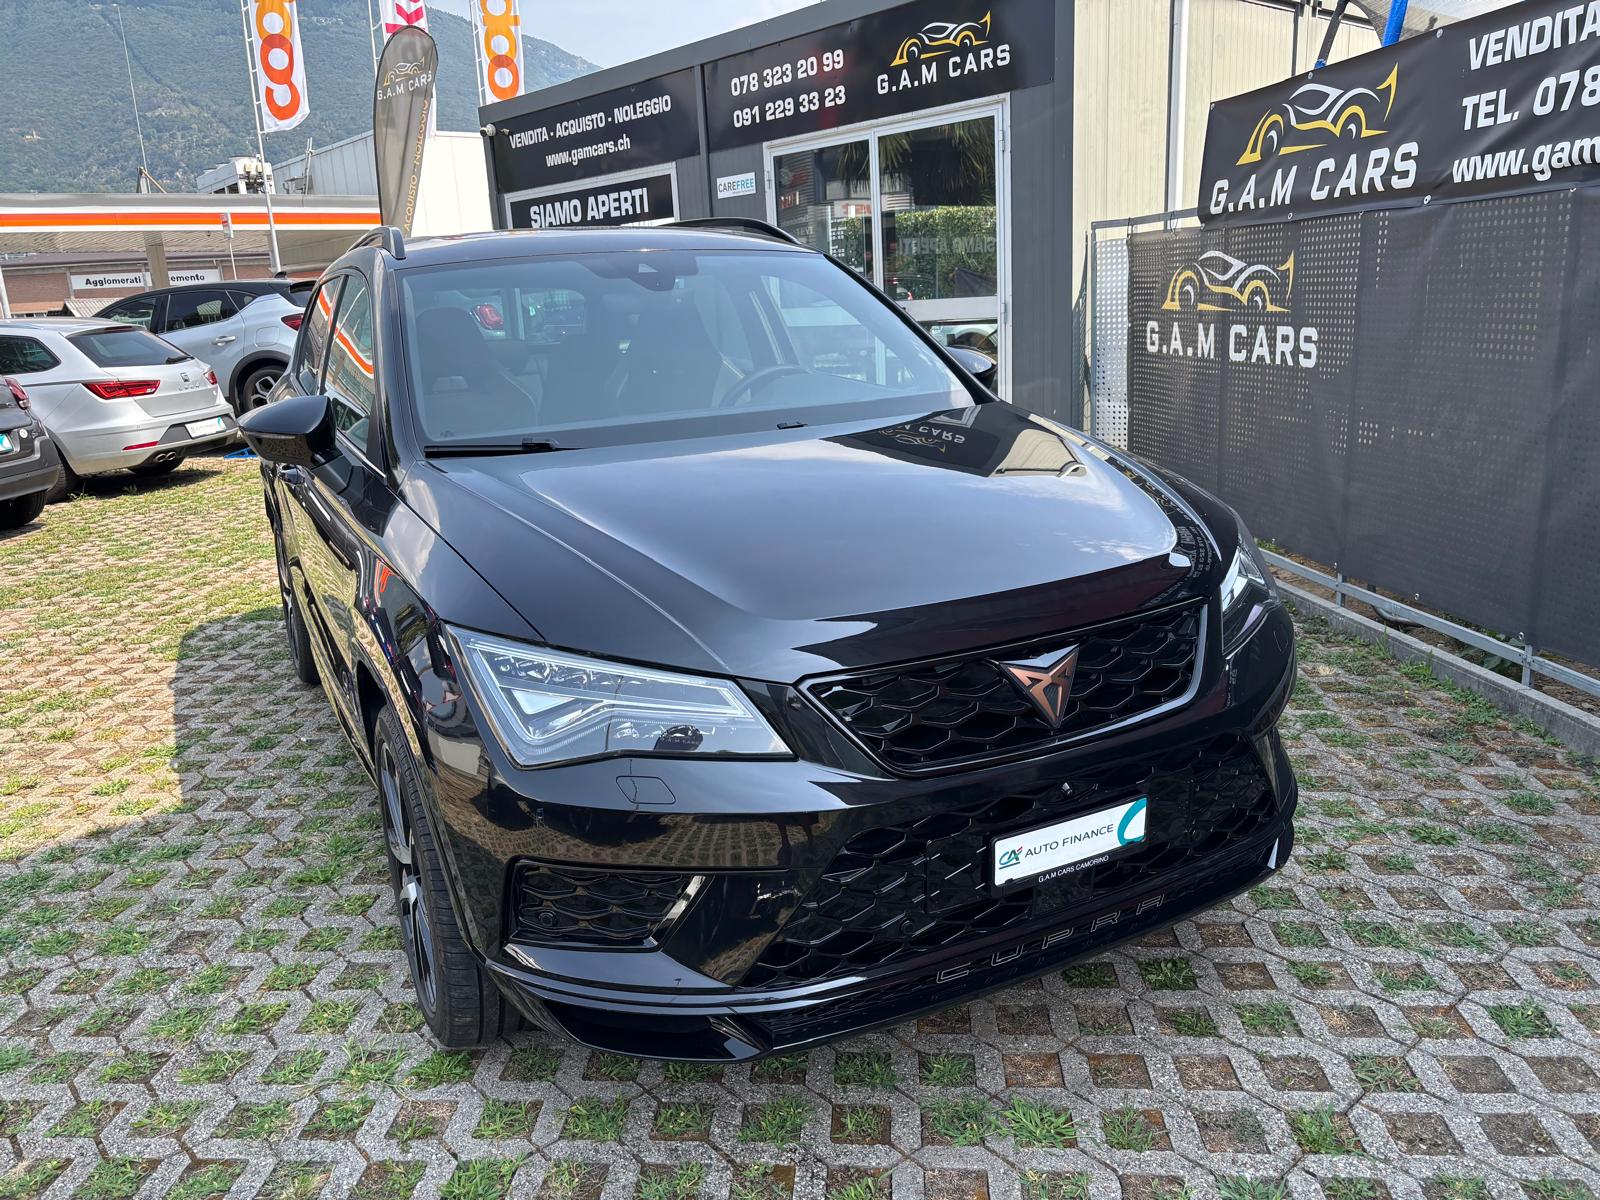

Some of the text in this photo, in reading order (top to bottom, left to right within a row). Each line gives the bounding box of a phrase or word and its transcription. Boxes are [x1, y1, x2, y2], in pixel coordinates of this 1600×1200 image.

[1469, 1, 1600, 71] VENDITA
[377, 70, 432, 100] G.A.M CARS
[731, 49, 844, 96] 078 323 20 99
[877, 44, 1011, 95] G.A.M CARS
[733, 85, 846, 128] 091 229 33 23
[1462, 65, 1600, 131] TEL. 078
[509, 126, 549, 149] VENDITA
[556, 111, 605, 139] ACQUISTO
[614, 95, 671, 124] NOLEGGIO
[545, 133, 631, 167] www.gamcars.ch
[1452, 136, 1600, 184] www.gam
[718, 178, 754, 193] CAREFREE
[1210, 141, 1419, 215] G.A.M CARS
[403, 175, 418, 232] ACQUISTO
[530, 187, 649, 228] SIAMO APERTI
[85, 273, 205, 287] Agglomerati emento
[1147, 320, 1319, 368] G.A.M CARS
[1024, 841, 1059, 858] AUTO
[1062, 824, 1114, 847] FINANCE
[1057, 865, 1075, 876] CARS
[1075, 855, 1109, 870] CAMORINO
[936, 894, 1164, 984] CUPRA
